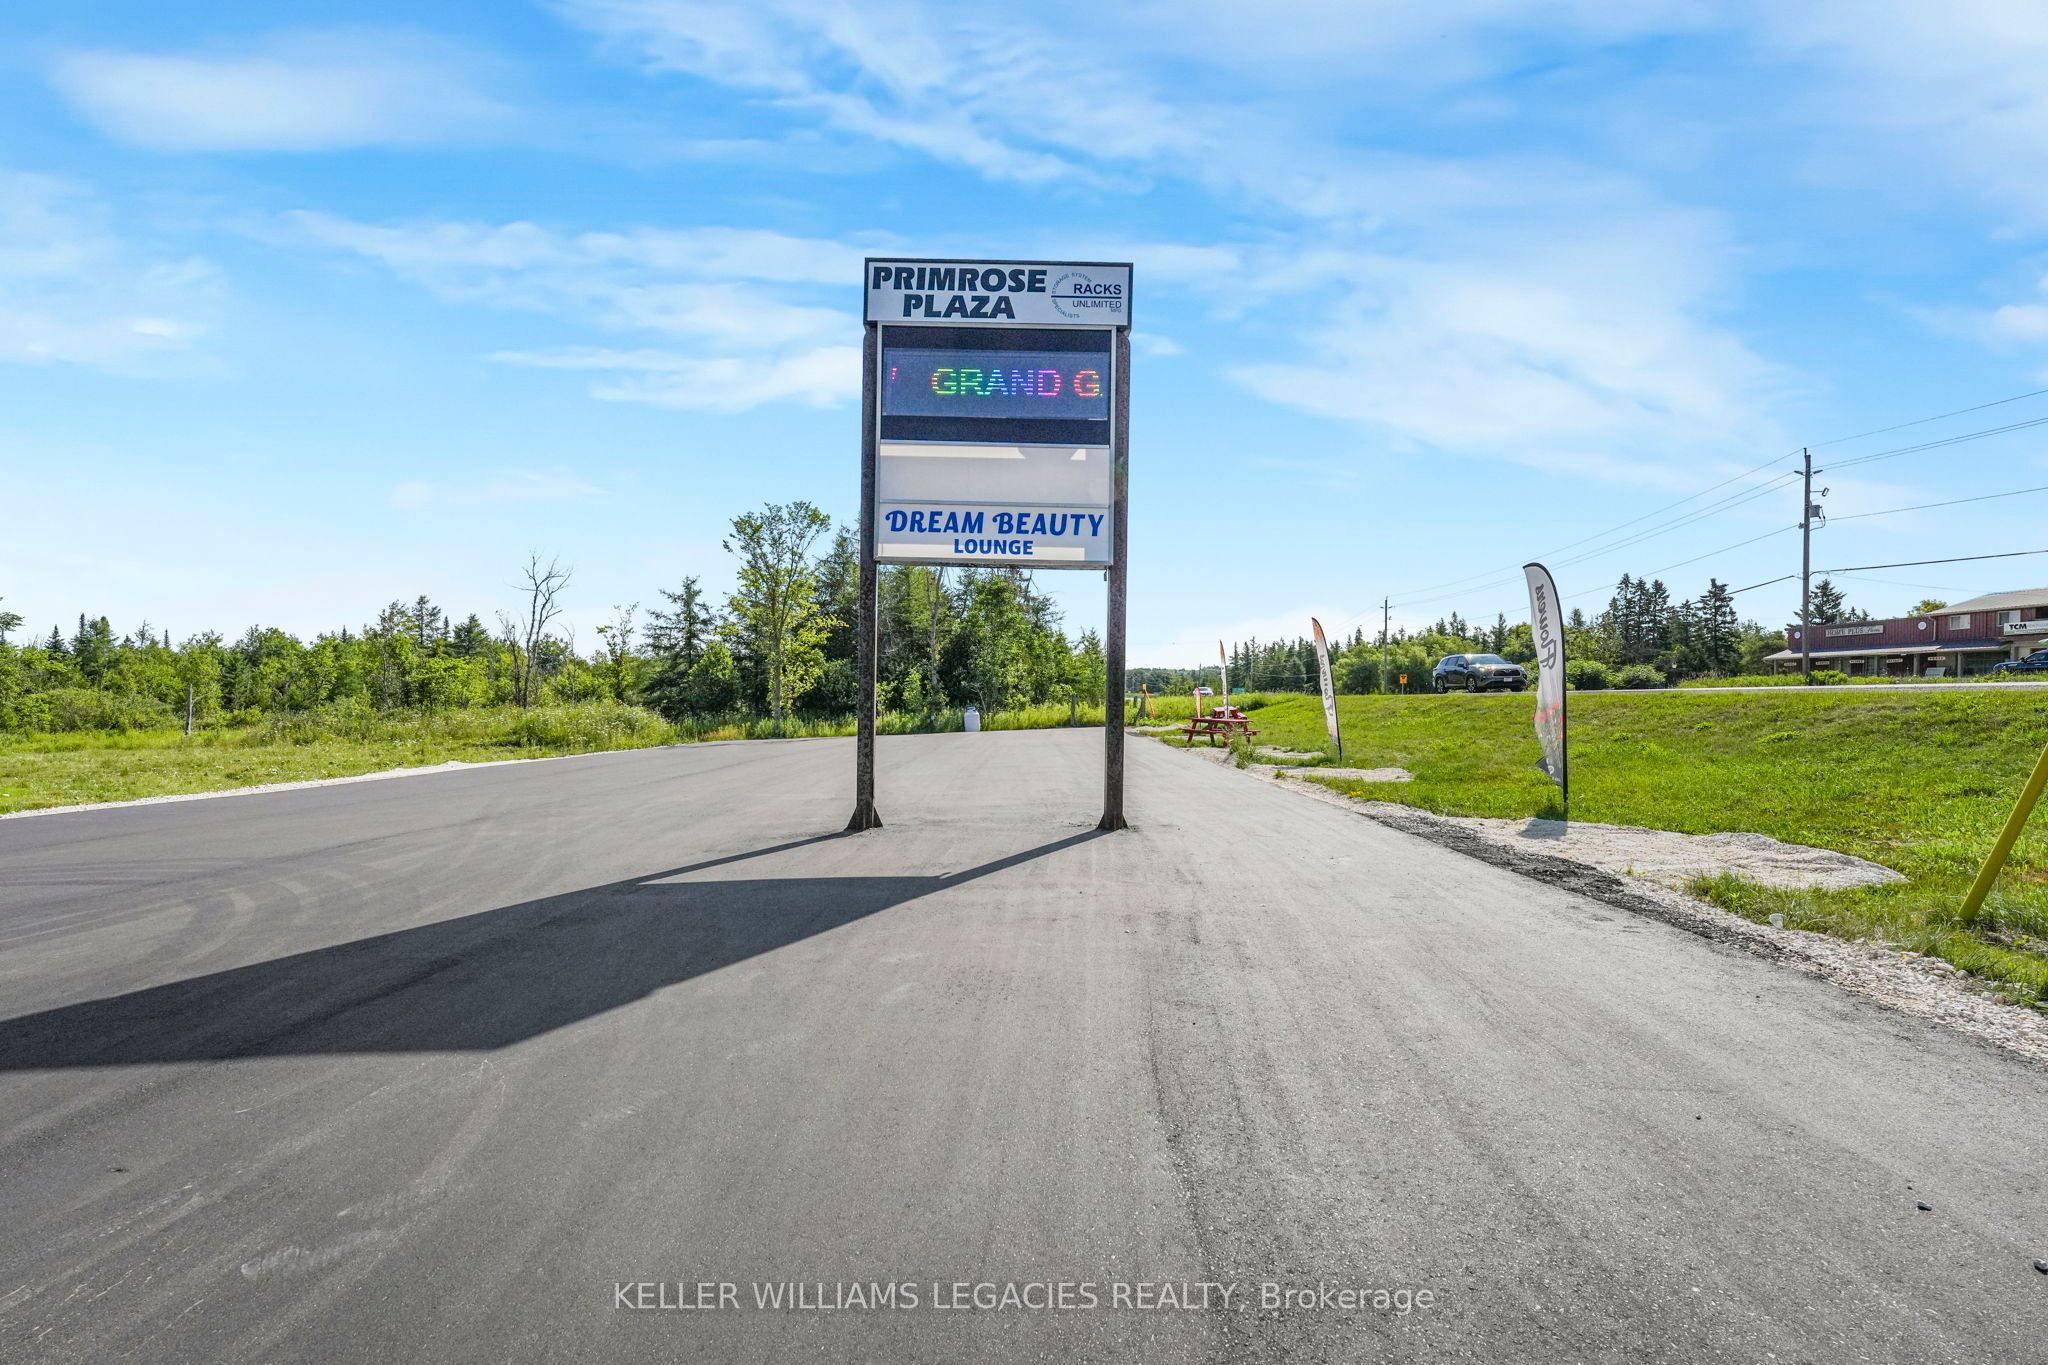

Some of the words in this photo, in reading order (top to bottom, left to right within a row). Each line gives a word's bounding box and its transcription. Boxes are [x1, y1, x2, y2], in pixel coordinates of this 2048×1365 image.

[872, 266, 1047, 293] PRIMROSE
[1073, 283, 1122, 295] RACKS
[903, 294, 1016, 320] PLAZA
[1051, 298, 1080, 319] SPECIALISTS
[1072, 300, 1122, 309] UNLIMITED
[931, 368, 1061, 395] GRAND
[885, 510, 984, 534] DREAM
[992, 512, 1104, 537] BEAUTY
[953, 538, 1033, 556] LOUNGE
